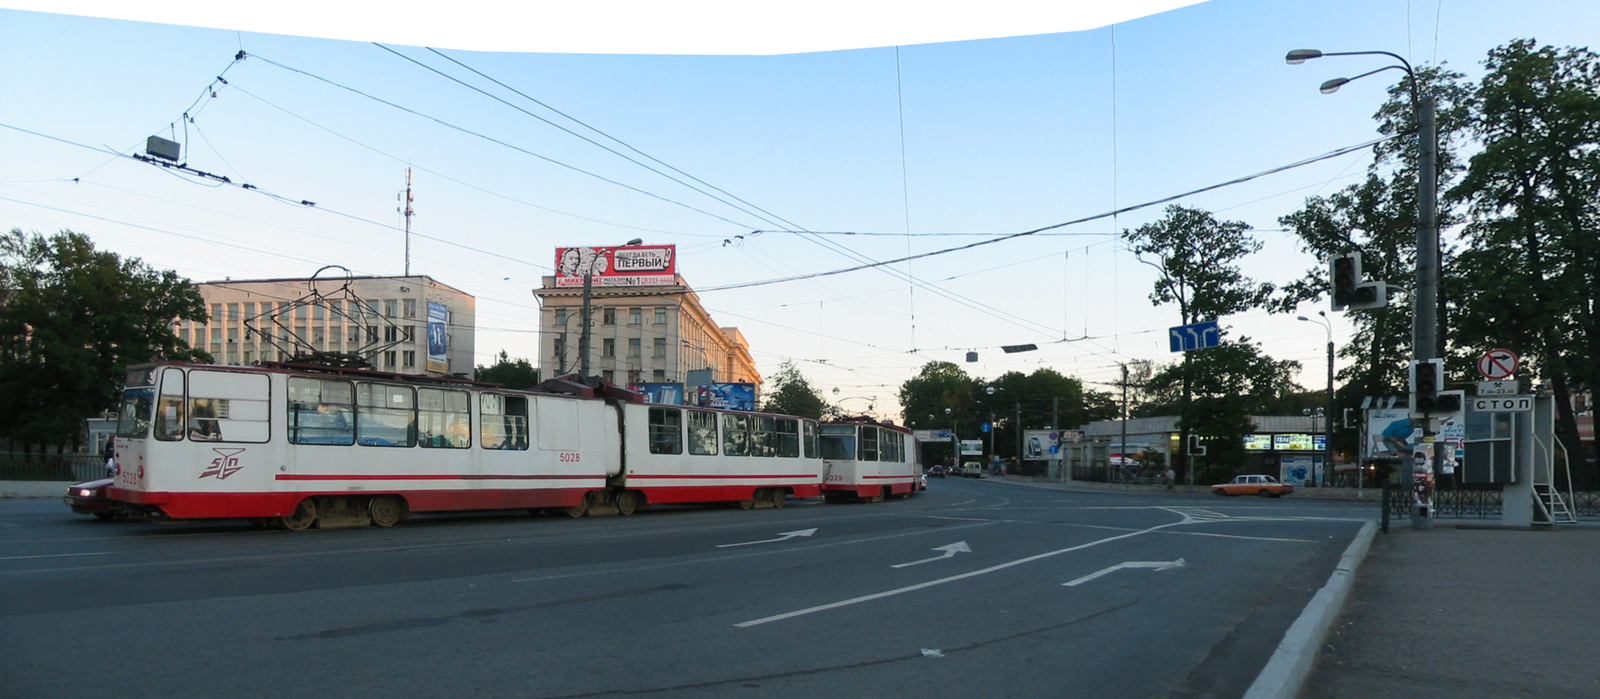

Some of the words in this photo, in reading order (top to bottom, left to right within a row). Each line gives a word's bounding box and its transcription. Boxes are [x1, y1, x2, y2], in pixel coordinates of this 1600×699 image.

[1476, 400, 1529, 410] СТОП
[560, 452, 580, 463] 5028
[122, 470, 137, 485] 5028
